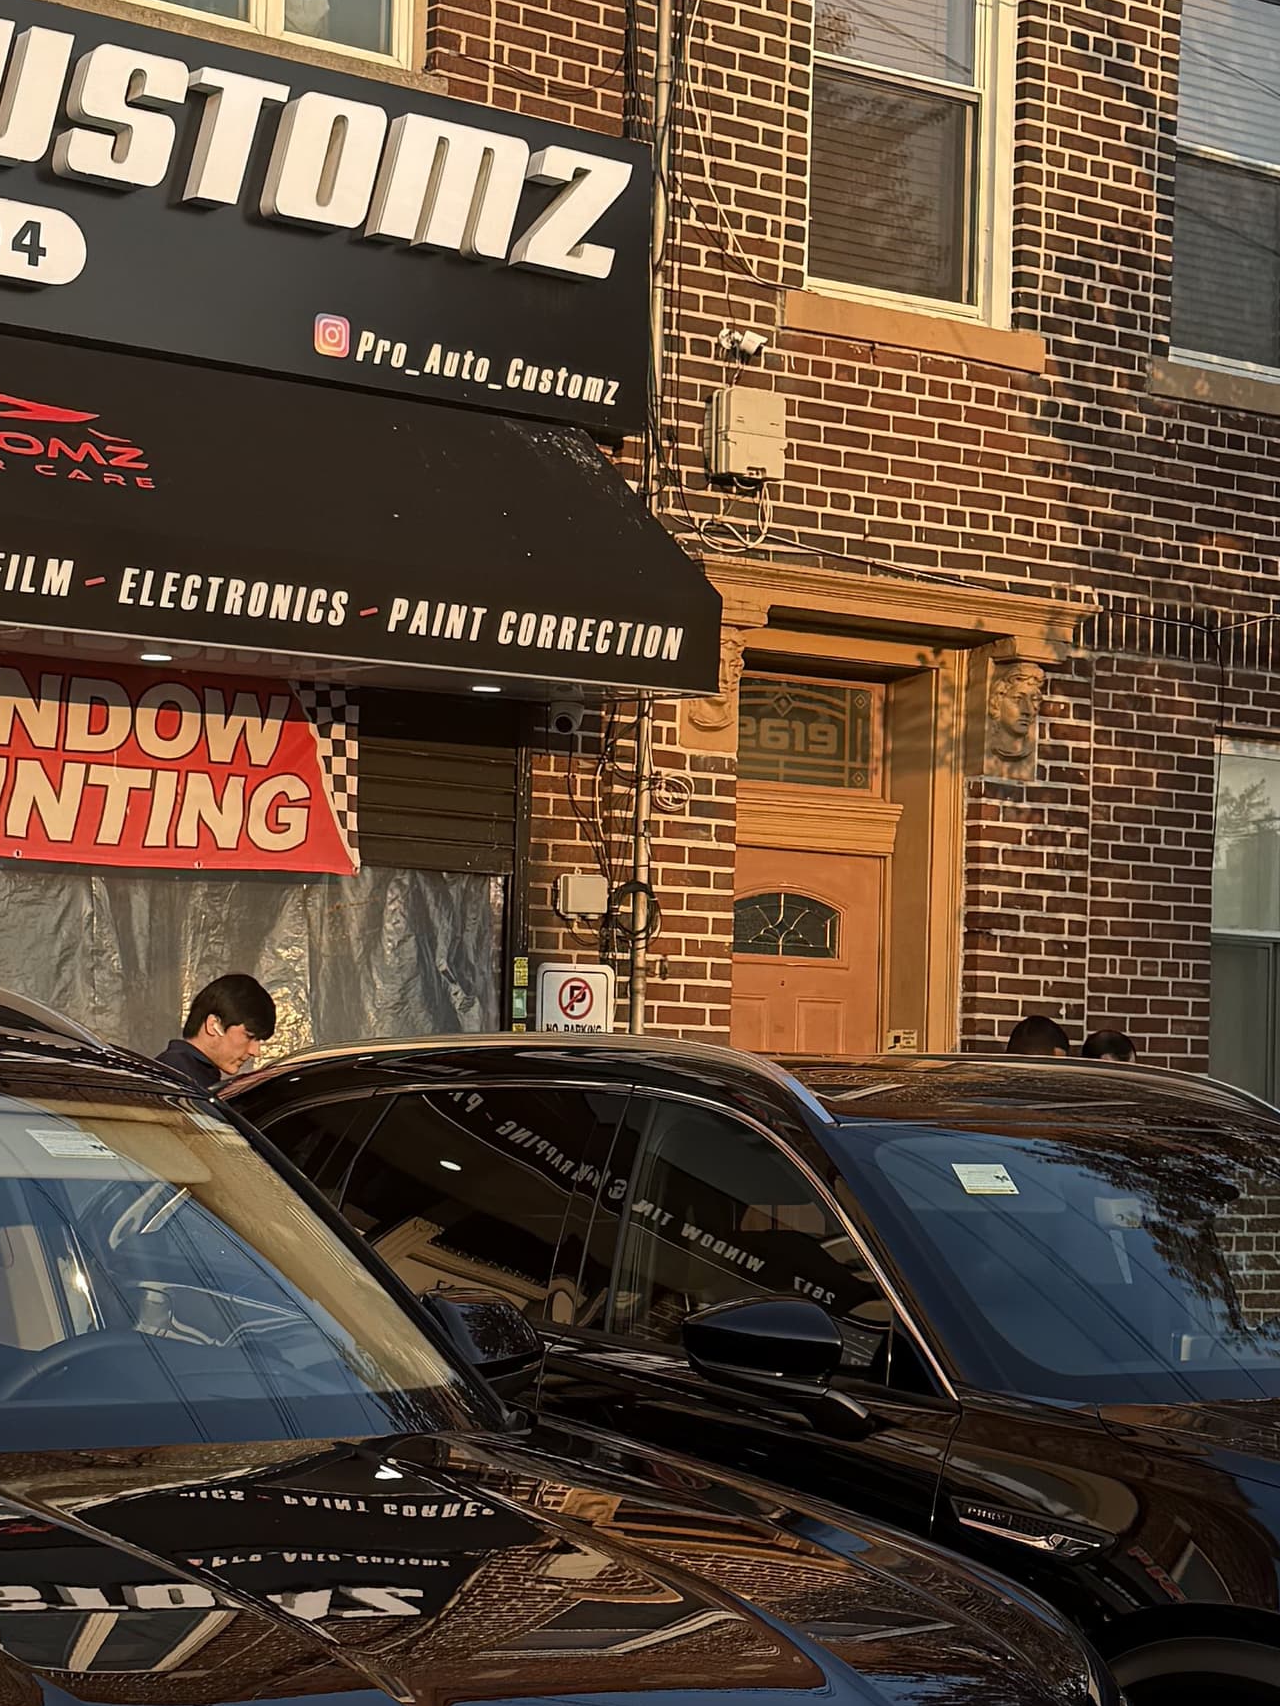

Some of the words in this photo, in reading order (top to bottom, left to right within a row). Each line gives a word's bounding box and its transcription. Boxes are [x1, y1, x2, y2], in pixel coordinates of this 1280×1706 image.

[355, 329, 619, 407] Pro_Auto_Customz
[34, 463, 156, 490] CARE
[117, 568, 349, 626] ELECTRONICS
[387, 596, 487, 643] PAINT
[496, 609, 684, 661] CORRECTION
[739, 715, 839, 755] 2619
